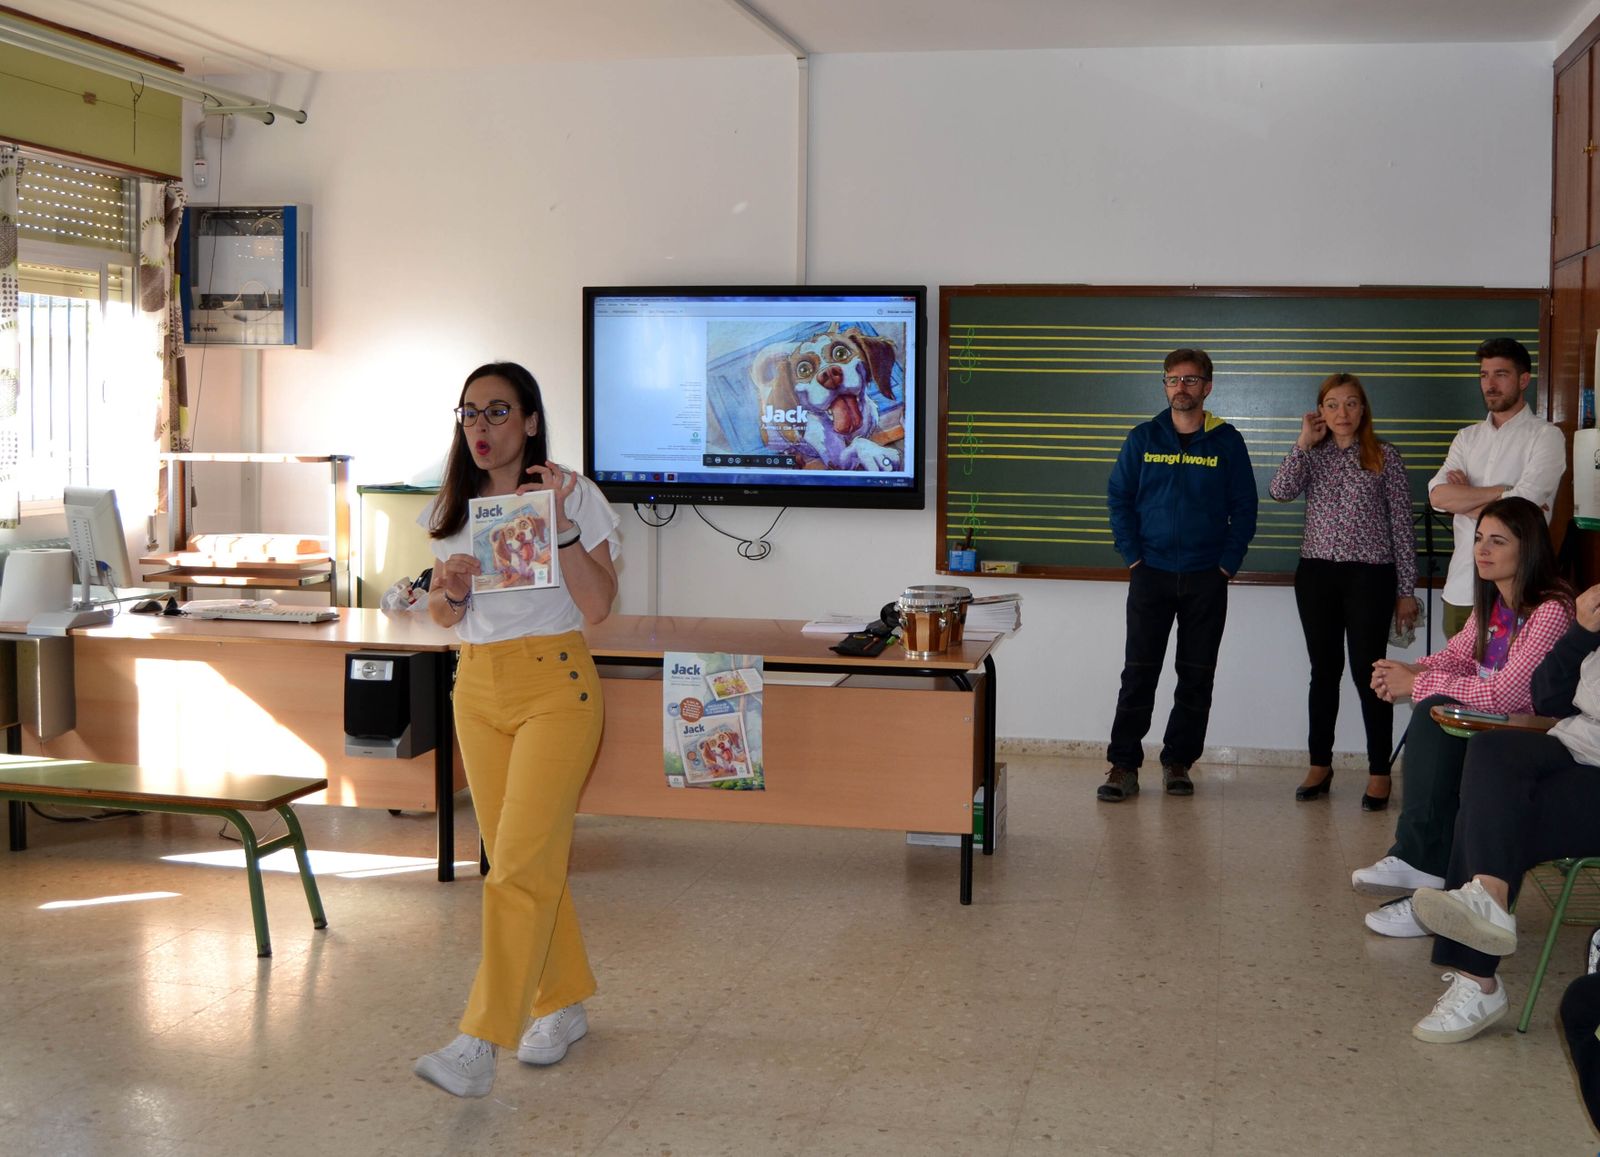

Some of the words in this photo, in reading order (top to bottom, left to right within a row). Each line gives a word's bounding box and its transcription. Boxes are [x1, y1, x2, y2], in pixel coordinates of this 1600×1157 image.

[761, 405, 808, 423] Jack
[475, 504, 503, 519] Jack
[672, 664, 700, 675] Jack
[683, 724, 705, 735] Jack
